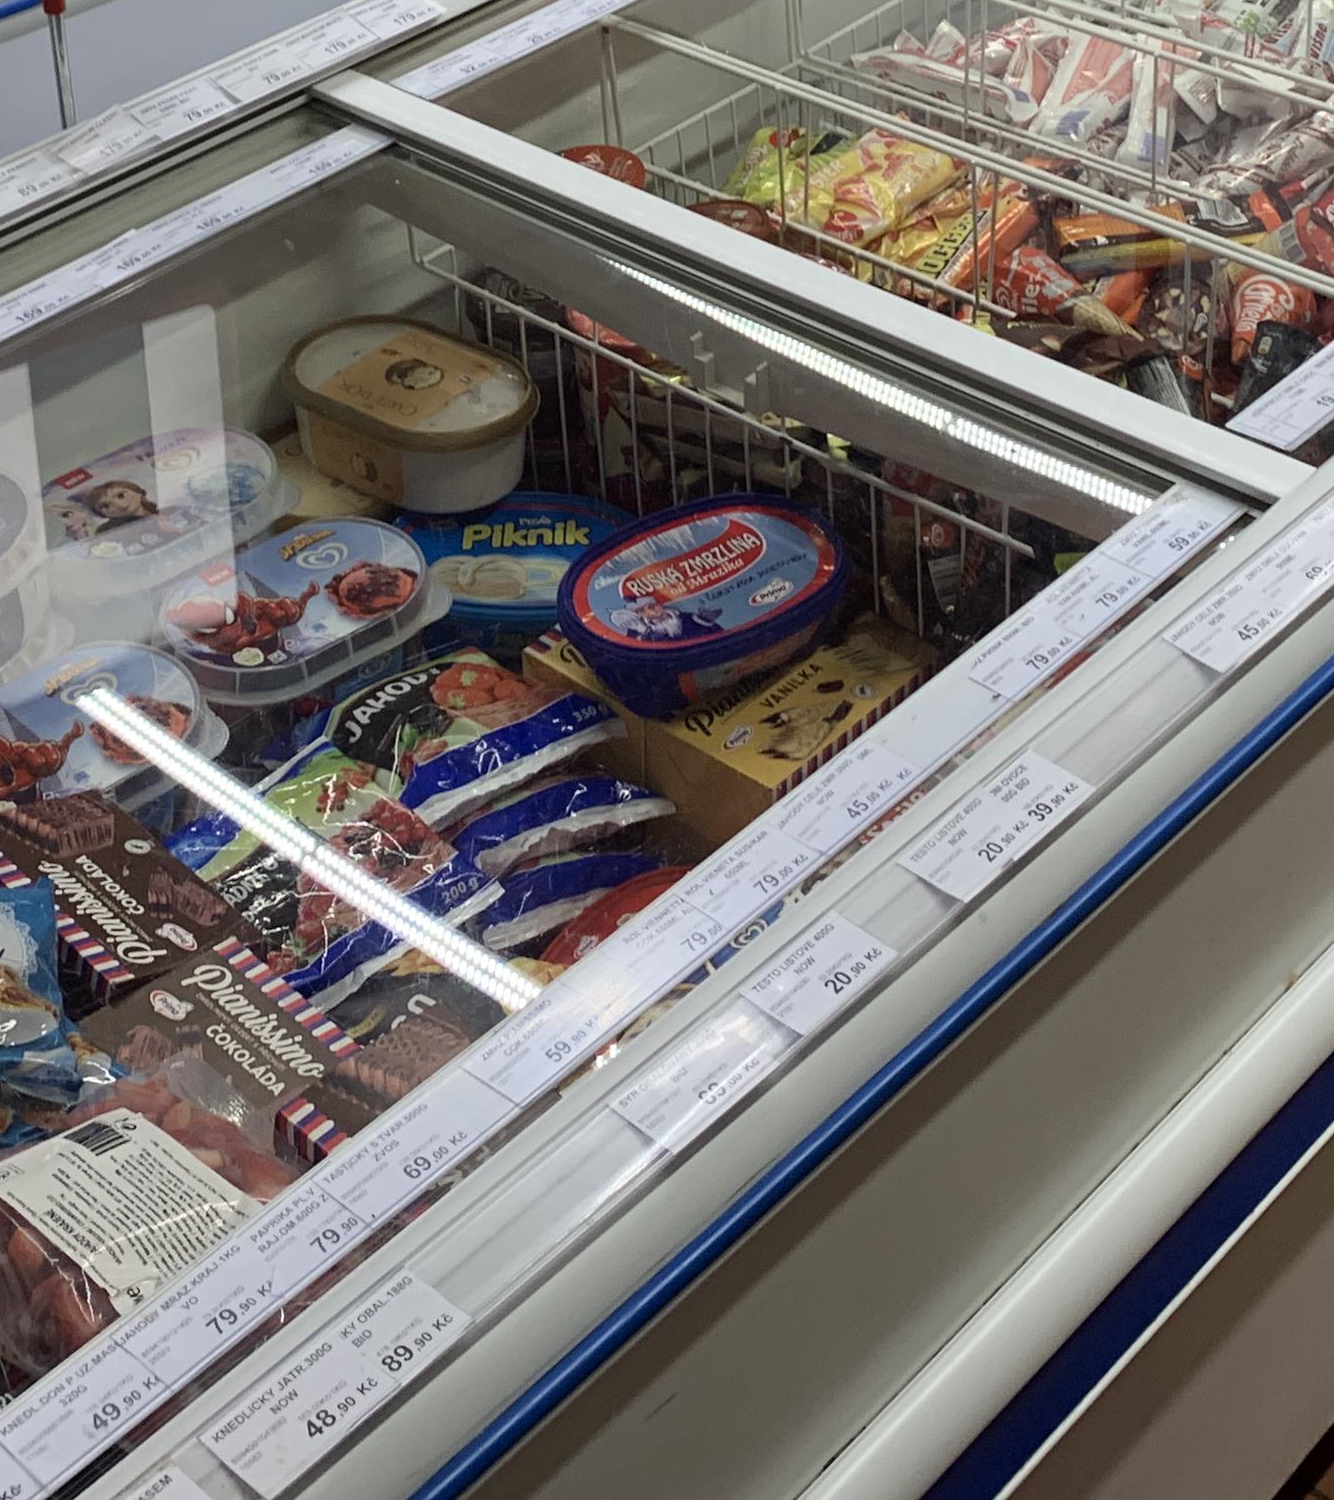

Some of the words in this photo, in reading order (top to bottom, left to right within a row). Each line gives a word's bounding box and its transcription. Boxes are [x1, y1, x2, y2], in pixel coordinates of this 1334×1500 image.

[461, 517, 590, 551] Piknik
[625, 564, 680, 599] RUSKÁ
[679, 532, 762, 581] ZMRZLINA
[759, 663, 822, 710] VANILKA
[571, 704, 598, 723] 350
[1062, 781, 1080, 796] Kč
[908, 839, 938, 864] TESTO
[934, 813, 966, 848] LISTOVE
[947, 828, 969, 847] NOW
[1012, 819, 1030, 835] Kč
[793, 853, 810, 869] Kč
[441, 883, 467, 904] 200
[750, 965, 783, 995] TESTO
[778, 937, 816, 975] LISTOVE
[809, 922, 835, 943] 400G
[792, 955, 817, 977] NOW
[823, 960, 868, 995] 20,90
[863, 946, 884, 964] Kč
[180, 964, 325, 1079] Pianissimo
[205, 1020, 286, 1098] ČOKOLÁDA
[321, 1147, 370, 1186] TASTICKY
[371, 1138, 401, 1164] ZVOS
[402, 1145, 450, 1181] 69,00
[449, 1129, 470, 1149] Kč
[250, 1209, 290, 1243] PAPRIKA
[309, 1216, 361, 1256] 79,90
[181, 1295, 199, 1314] VO
[205, 1296, 258, 1338] 79,90
[119, 1312, 162, 1351] JAHODY
[350, 1328, 374, 1350] BID
[380, 1330, 435, 1373] 89,90
[433, 1311, 455, 1334] Kč
[59, 1384, 88, 1408] 320G
[90, 1388, 142, 1433] 49,90
[210, 1388, 277, 1443] KNEDLICKY
[269, 1388, 300, 1415] NOW
[305, 1395, 357, 1442] 48,90
[355, 1376, 380, 1398] Kč
